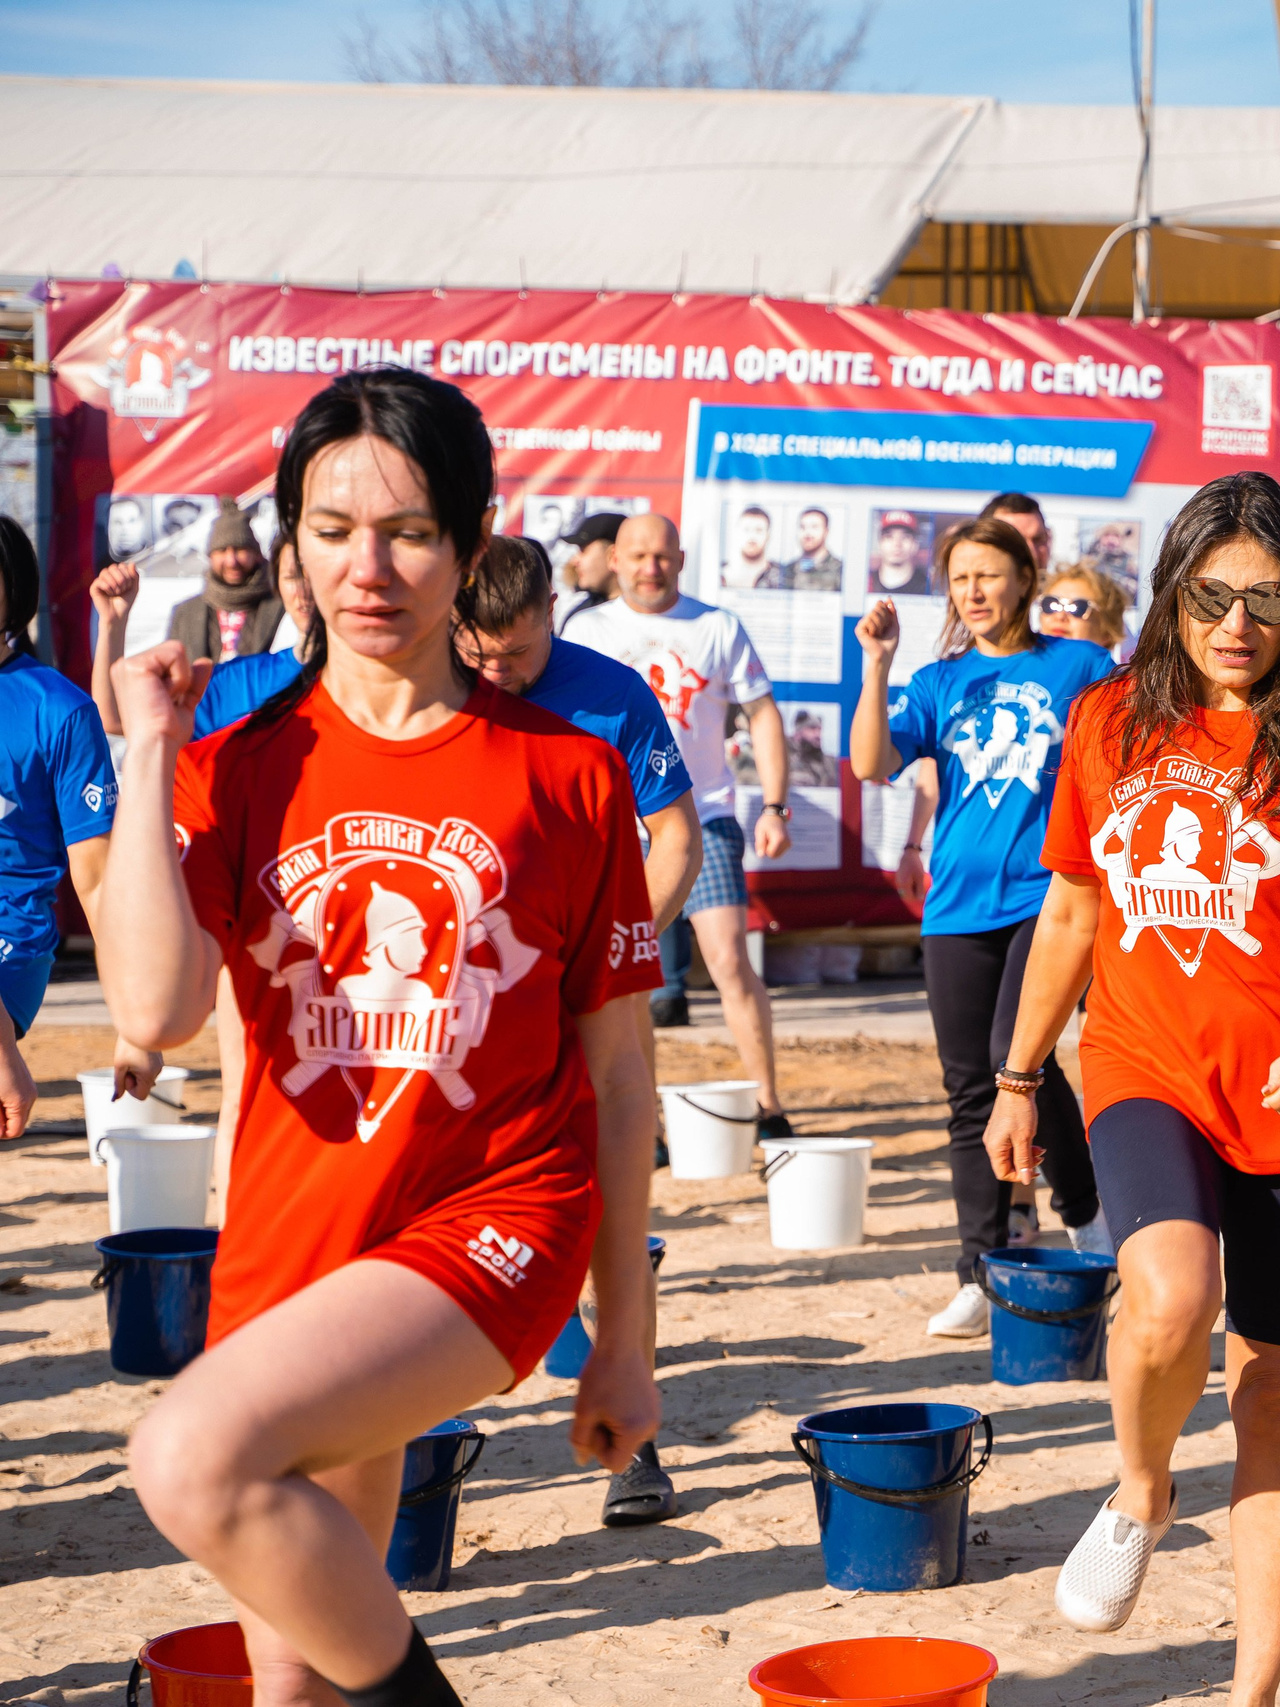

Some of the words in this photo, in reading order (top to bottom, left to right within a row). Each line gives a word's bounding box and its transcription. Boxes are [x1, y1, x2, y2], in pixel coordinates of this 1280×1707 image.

[228, 335, 435, 373] ИЗВЕСТНЫЕ
[440, 340, 677, 380] СПОРТСМЕНЫ
[682, 345, 729, 381] НА
[734, 344, 881, 386] ФРОНТЕ.
[888, 355, 993, 396] ТОГДА
[999, 358, 1025, 392] И
[1031, 354, 1164, 400] СЕЙЧАС
[592, 426, 662, 451] ВОЙНЫ
[731, 433, 782, 457] ХОДЕ
[784, 433, 923, 461] СПЕЦИАЛЬНОЙ
[925, 436, 1014, 465] ВОЕННОЙ
[1015, 443, 1117, 471] ОПЕРАЦИИ
[1115, 774, 1147, 804] СИЛА
[1166, 761, 1217, 789] СЛАВА
[269, 848, 323, 898] СИЛА
[344, 818, 425, 855] СЛАВА
[440, 820, 497, 874] ДОЛГ
[1127, 881, 1234, 920] ЯРОПОЛК
[305, 1002, 461, 1055] ЯРОПОЛК
[466, 1239, 528, 1283] SPORT
